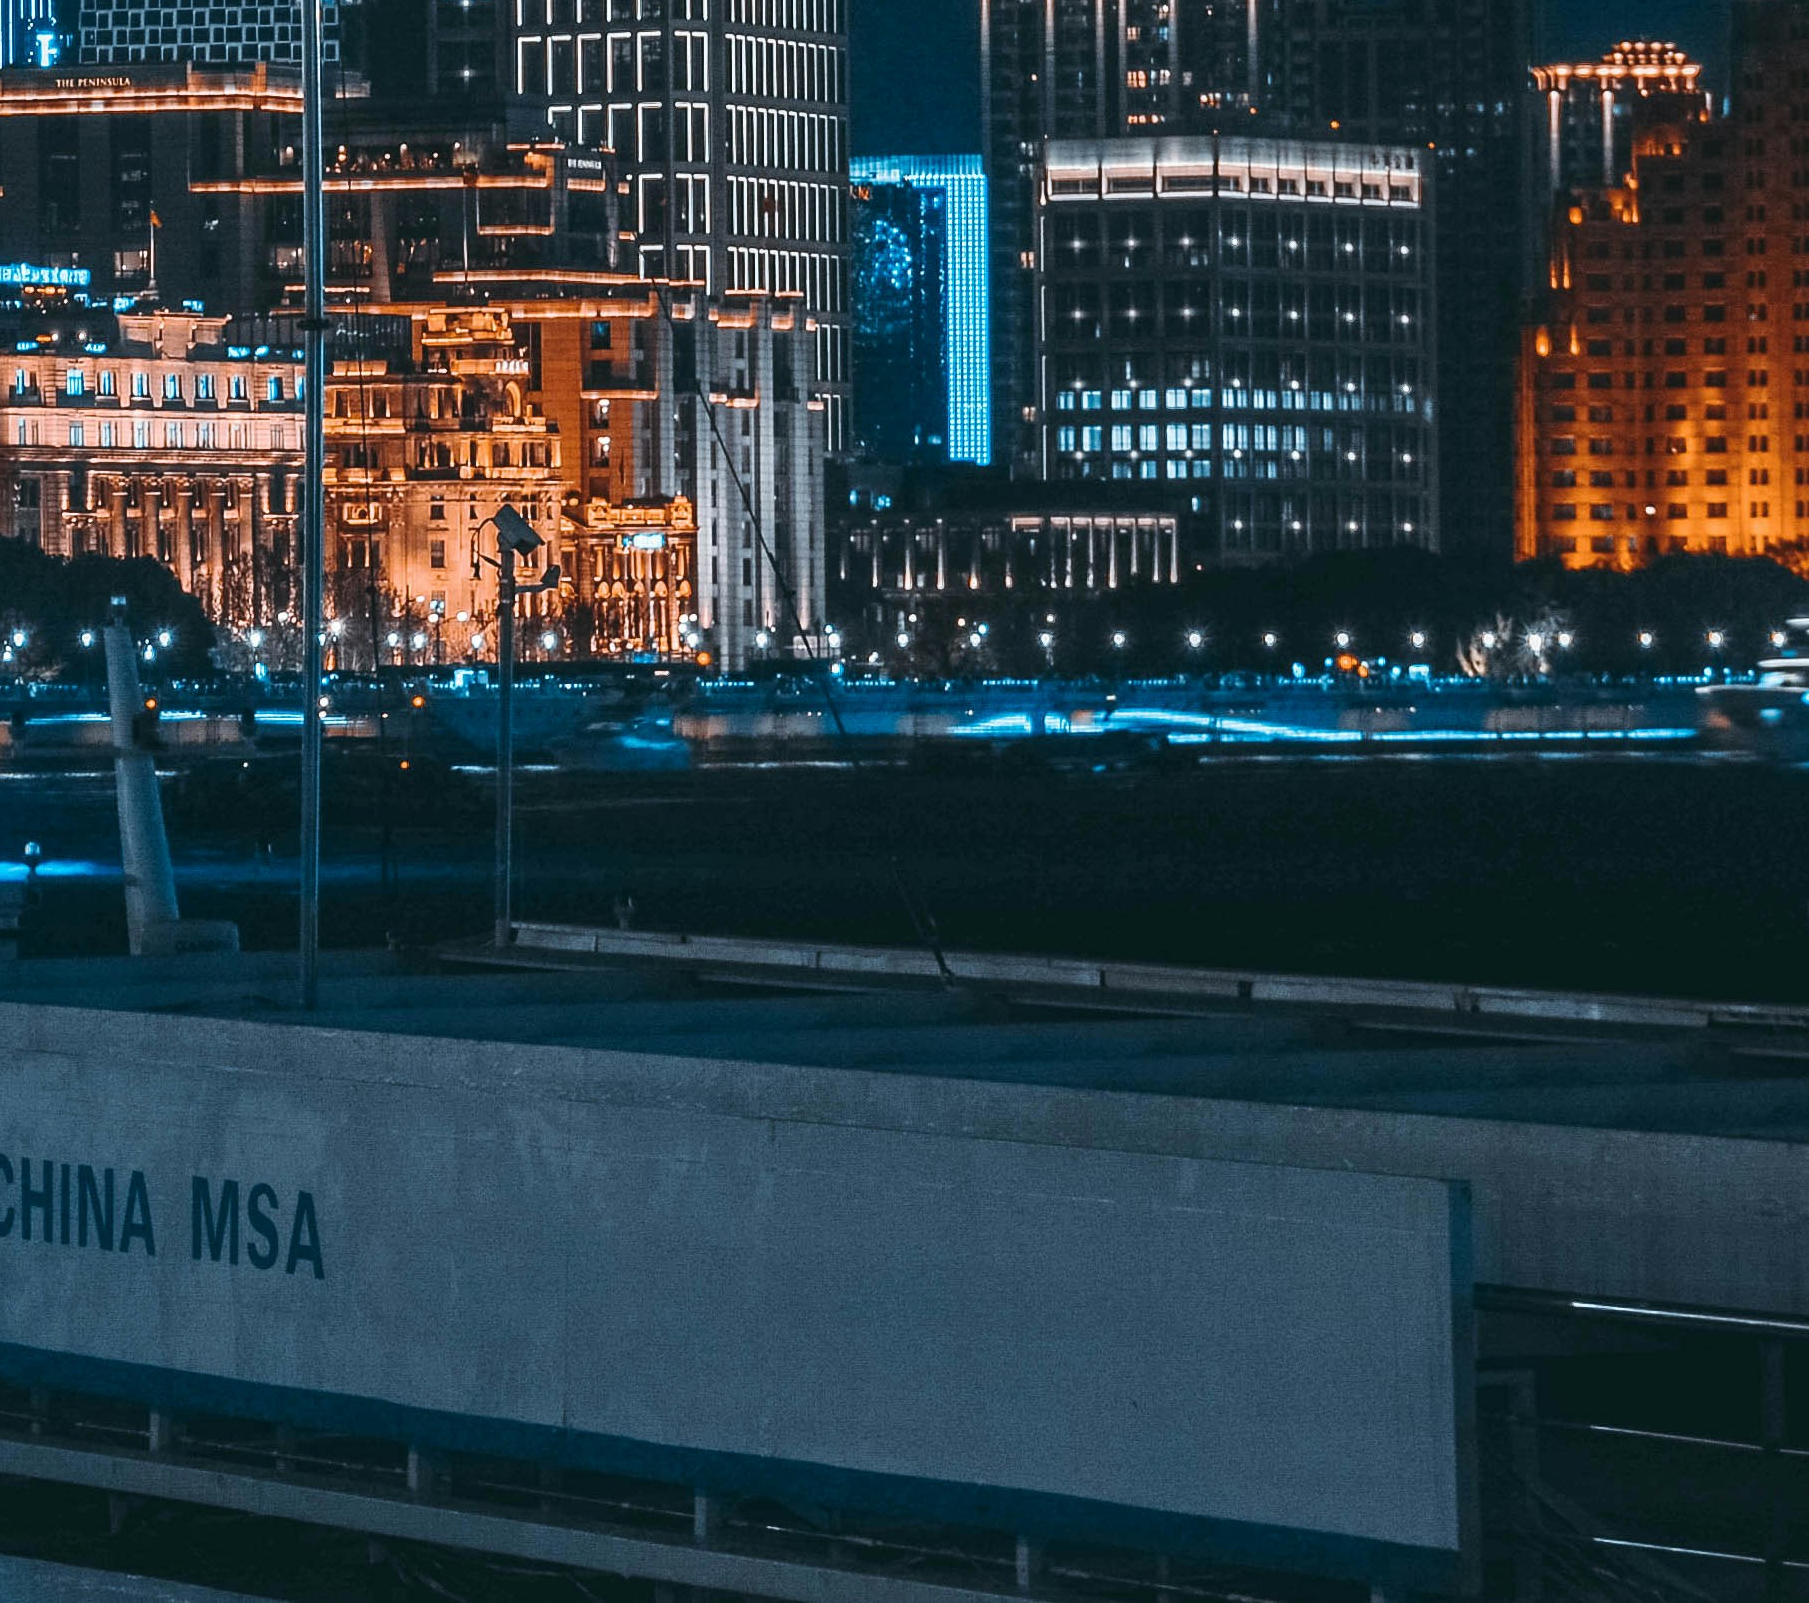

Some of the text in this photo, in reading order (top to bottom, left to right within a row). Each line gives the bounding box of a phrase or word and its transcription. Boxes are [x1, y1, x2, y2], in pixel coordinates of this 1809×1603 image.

[55, 77, 131, 88] THE PENINSULA
[191, 1175, 326, 1281] MSA
